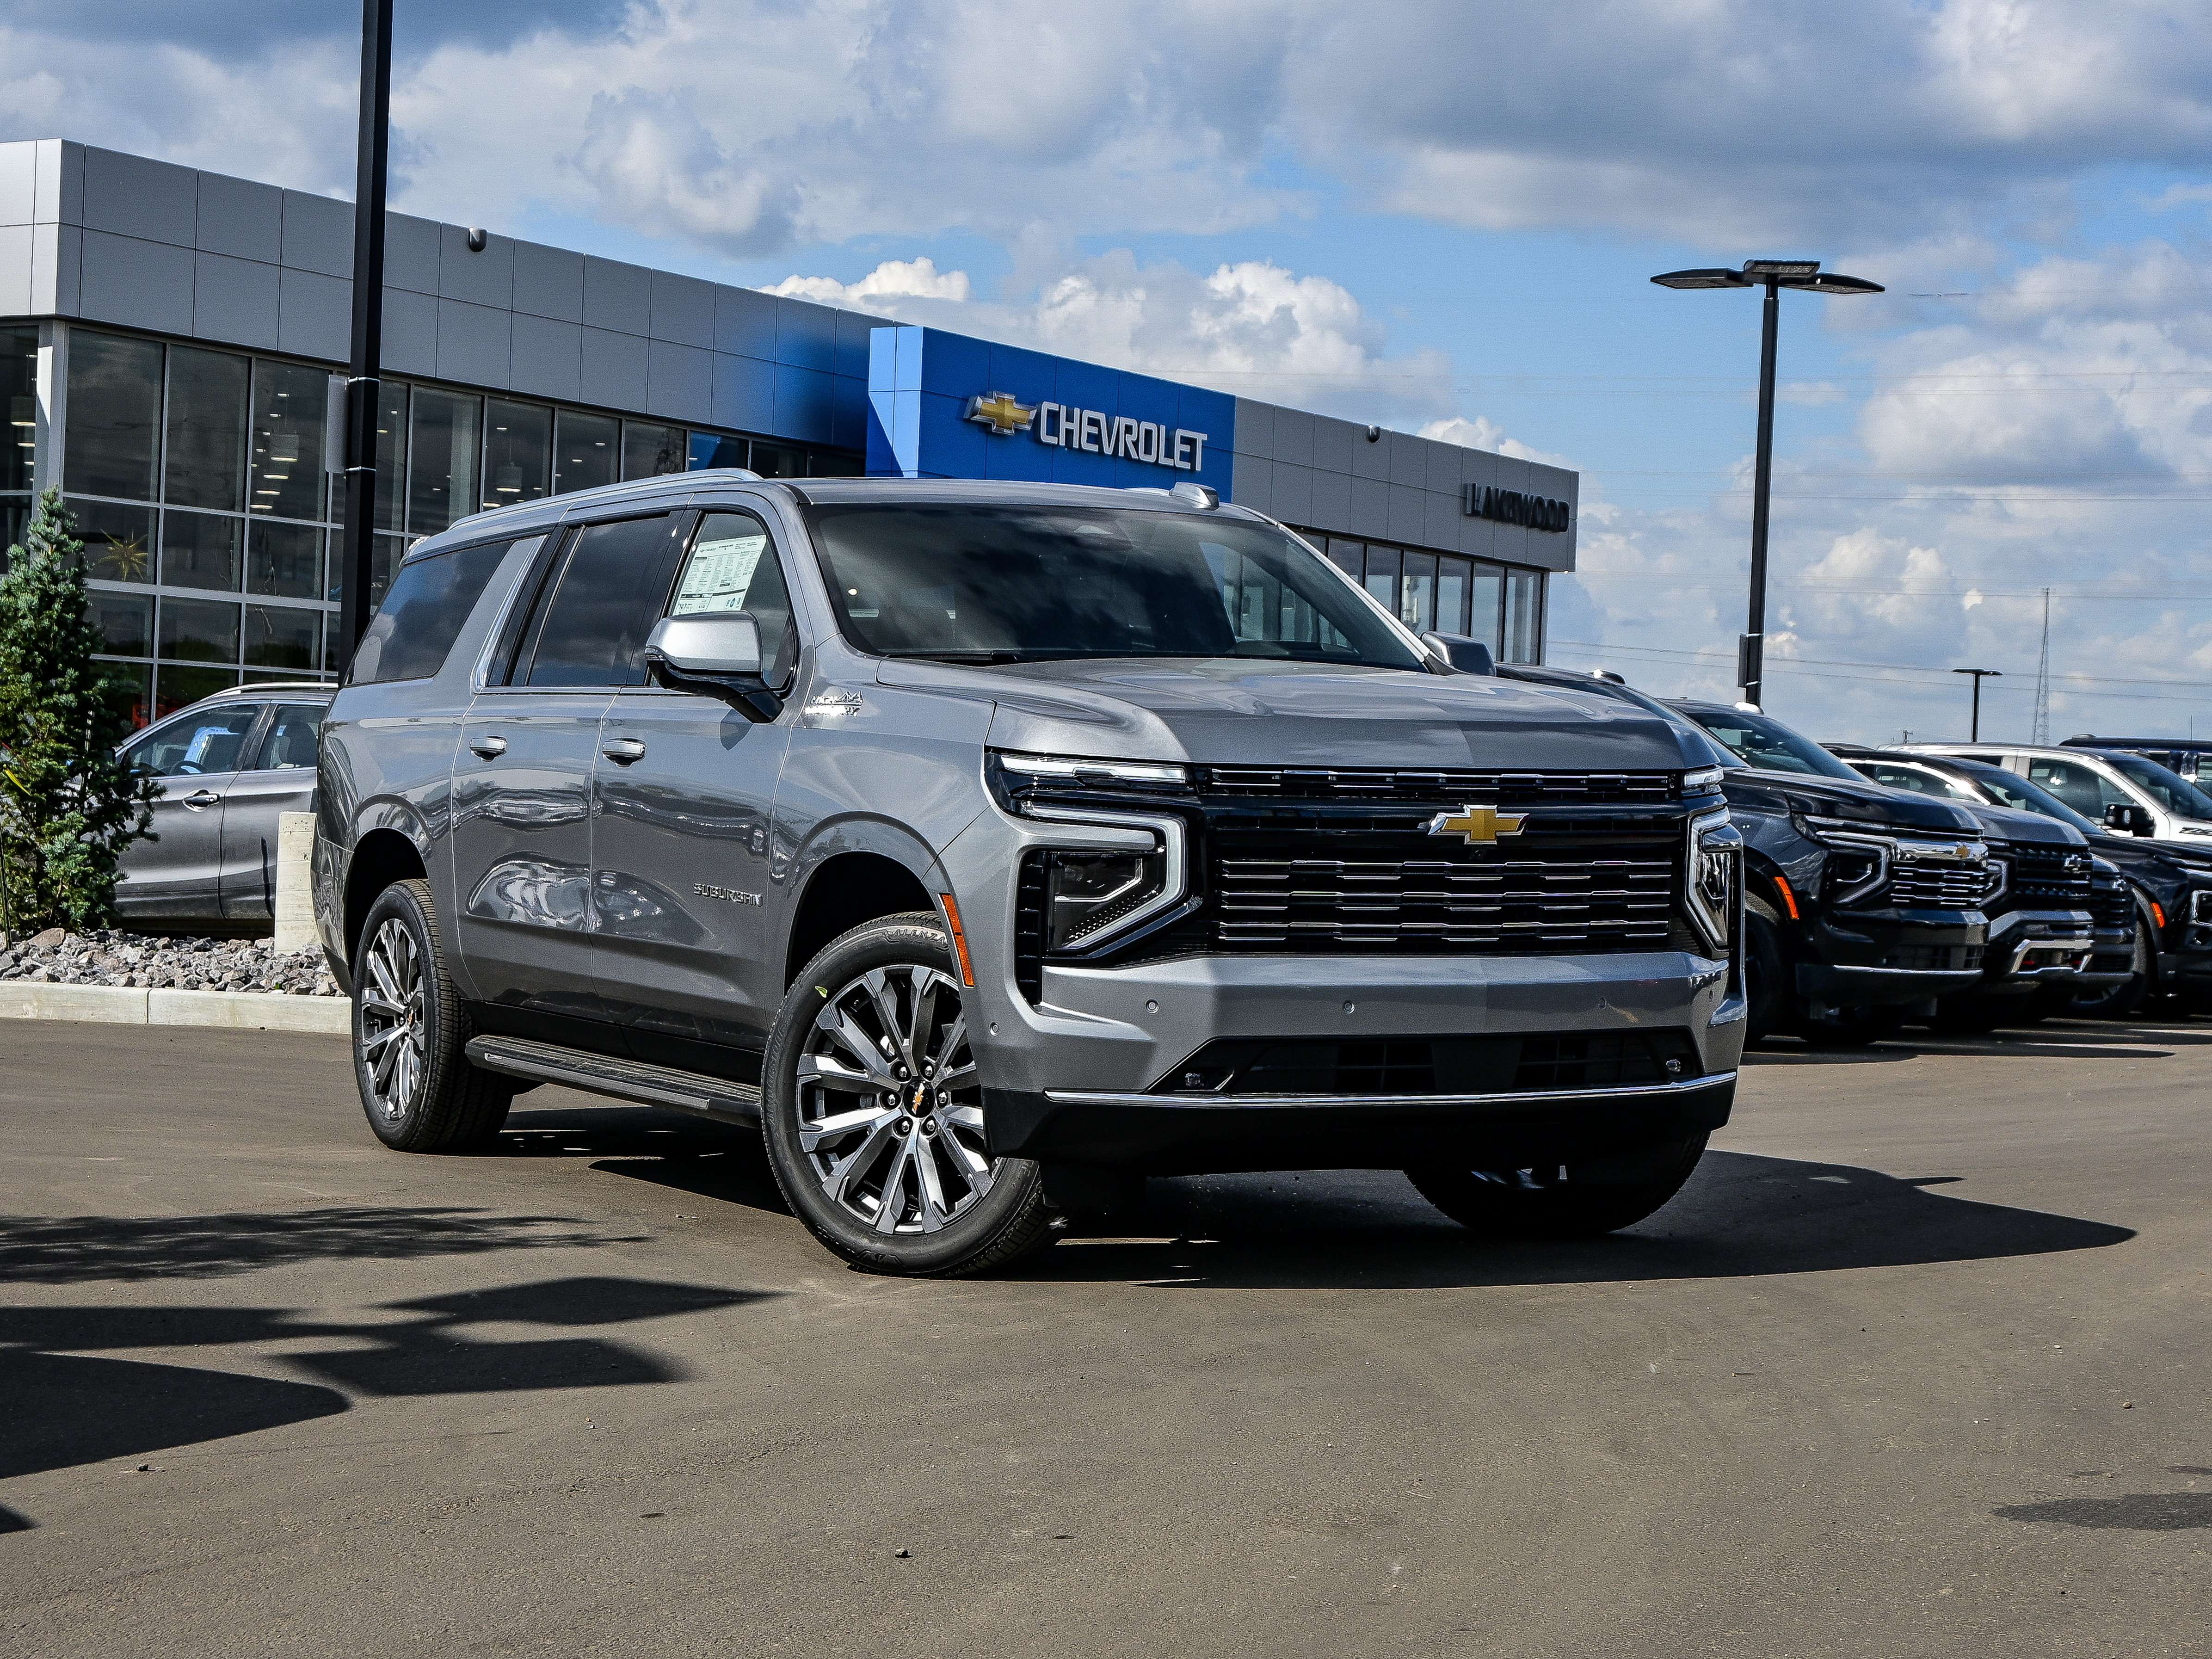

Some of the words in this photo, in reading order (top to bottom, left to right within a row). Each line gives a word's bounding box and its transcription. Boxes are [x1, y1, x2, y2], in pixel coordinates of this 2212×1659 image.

[1040, 401, 1208, 471] CHEVROLET
[1465, 482, 1570, 532] LAKEWOOD
[694, 883, 762, 907] SUBURBAN
[893, 928, 945, 945] ALENZA
